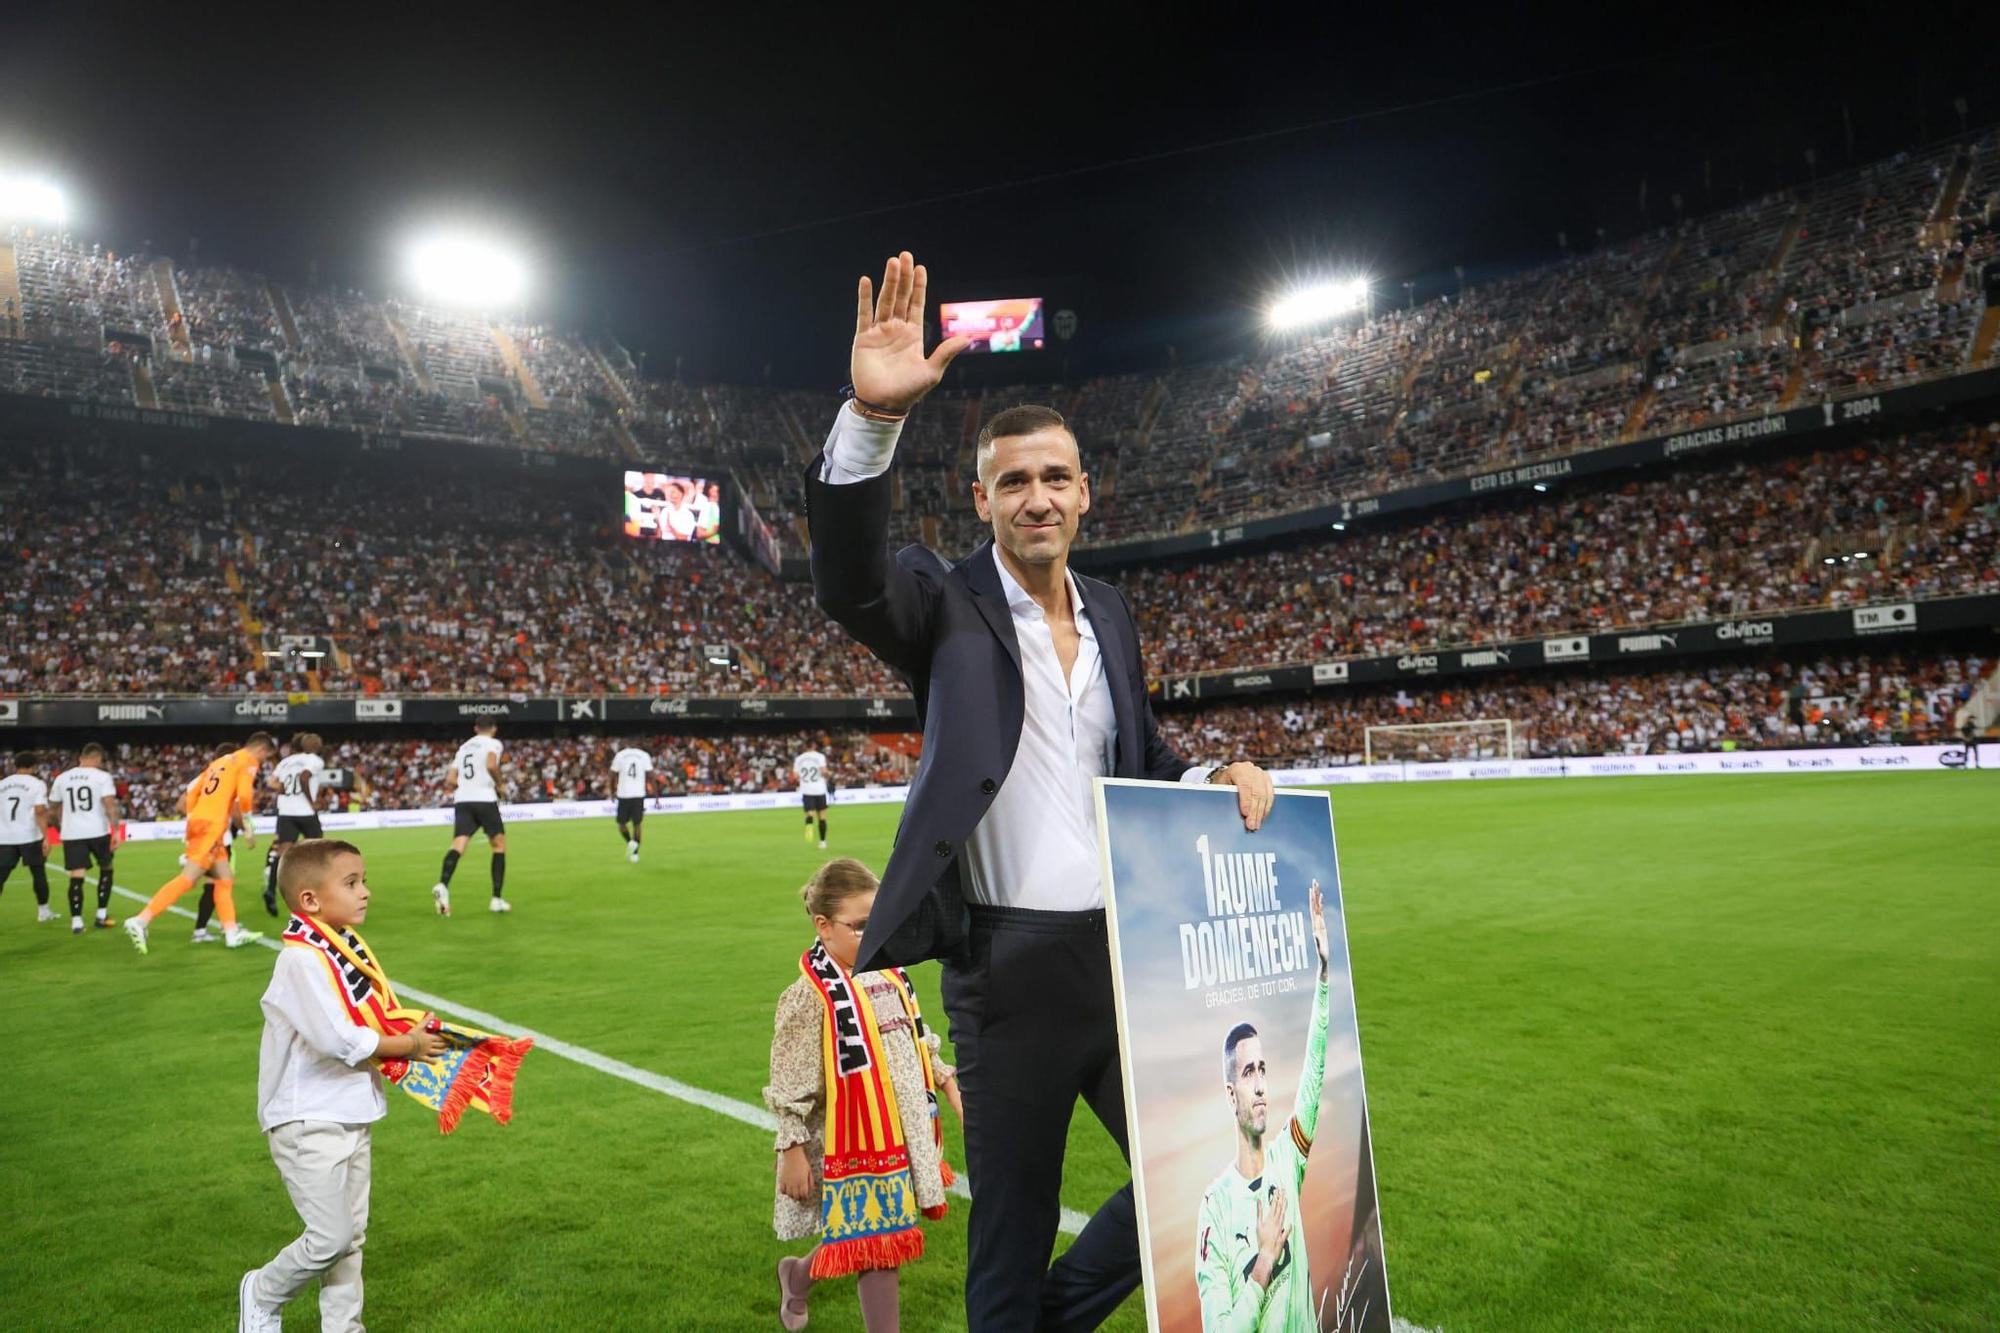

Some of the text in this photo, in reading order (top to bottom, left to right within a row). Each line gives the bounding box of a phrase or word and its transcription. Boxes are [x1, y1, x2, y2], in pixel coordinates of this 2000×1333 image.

[1842, 397, 1881, 418] 2004
[1726, 415, 1786, 441] AFICIÓN!
[1516, 460, 1572, 482] MESTALLA
[1858, 613, 1880, 624] TM
[1716, 621, 1773, 639] divina
[1397, 654, 1438, 670] divina
[99, 704, 147, 720] PUMA
[235, 700, 288, 716] divina
[463, 753, 475, 780] 5
[628, 762, 636, 779] 4
[800, 766, 818, 783] 22
[8, 796, 20, 822] 7
[65, 786, 93, 813] 19
[1247, 983, 1260, 1000] DE
[1261, 980, 1276, 997] TOT
